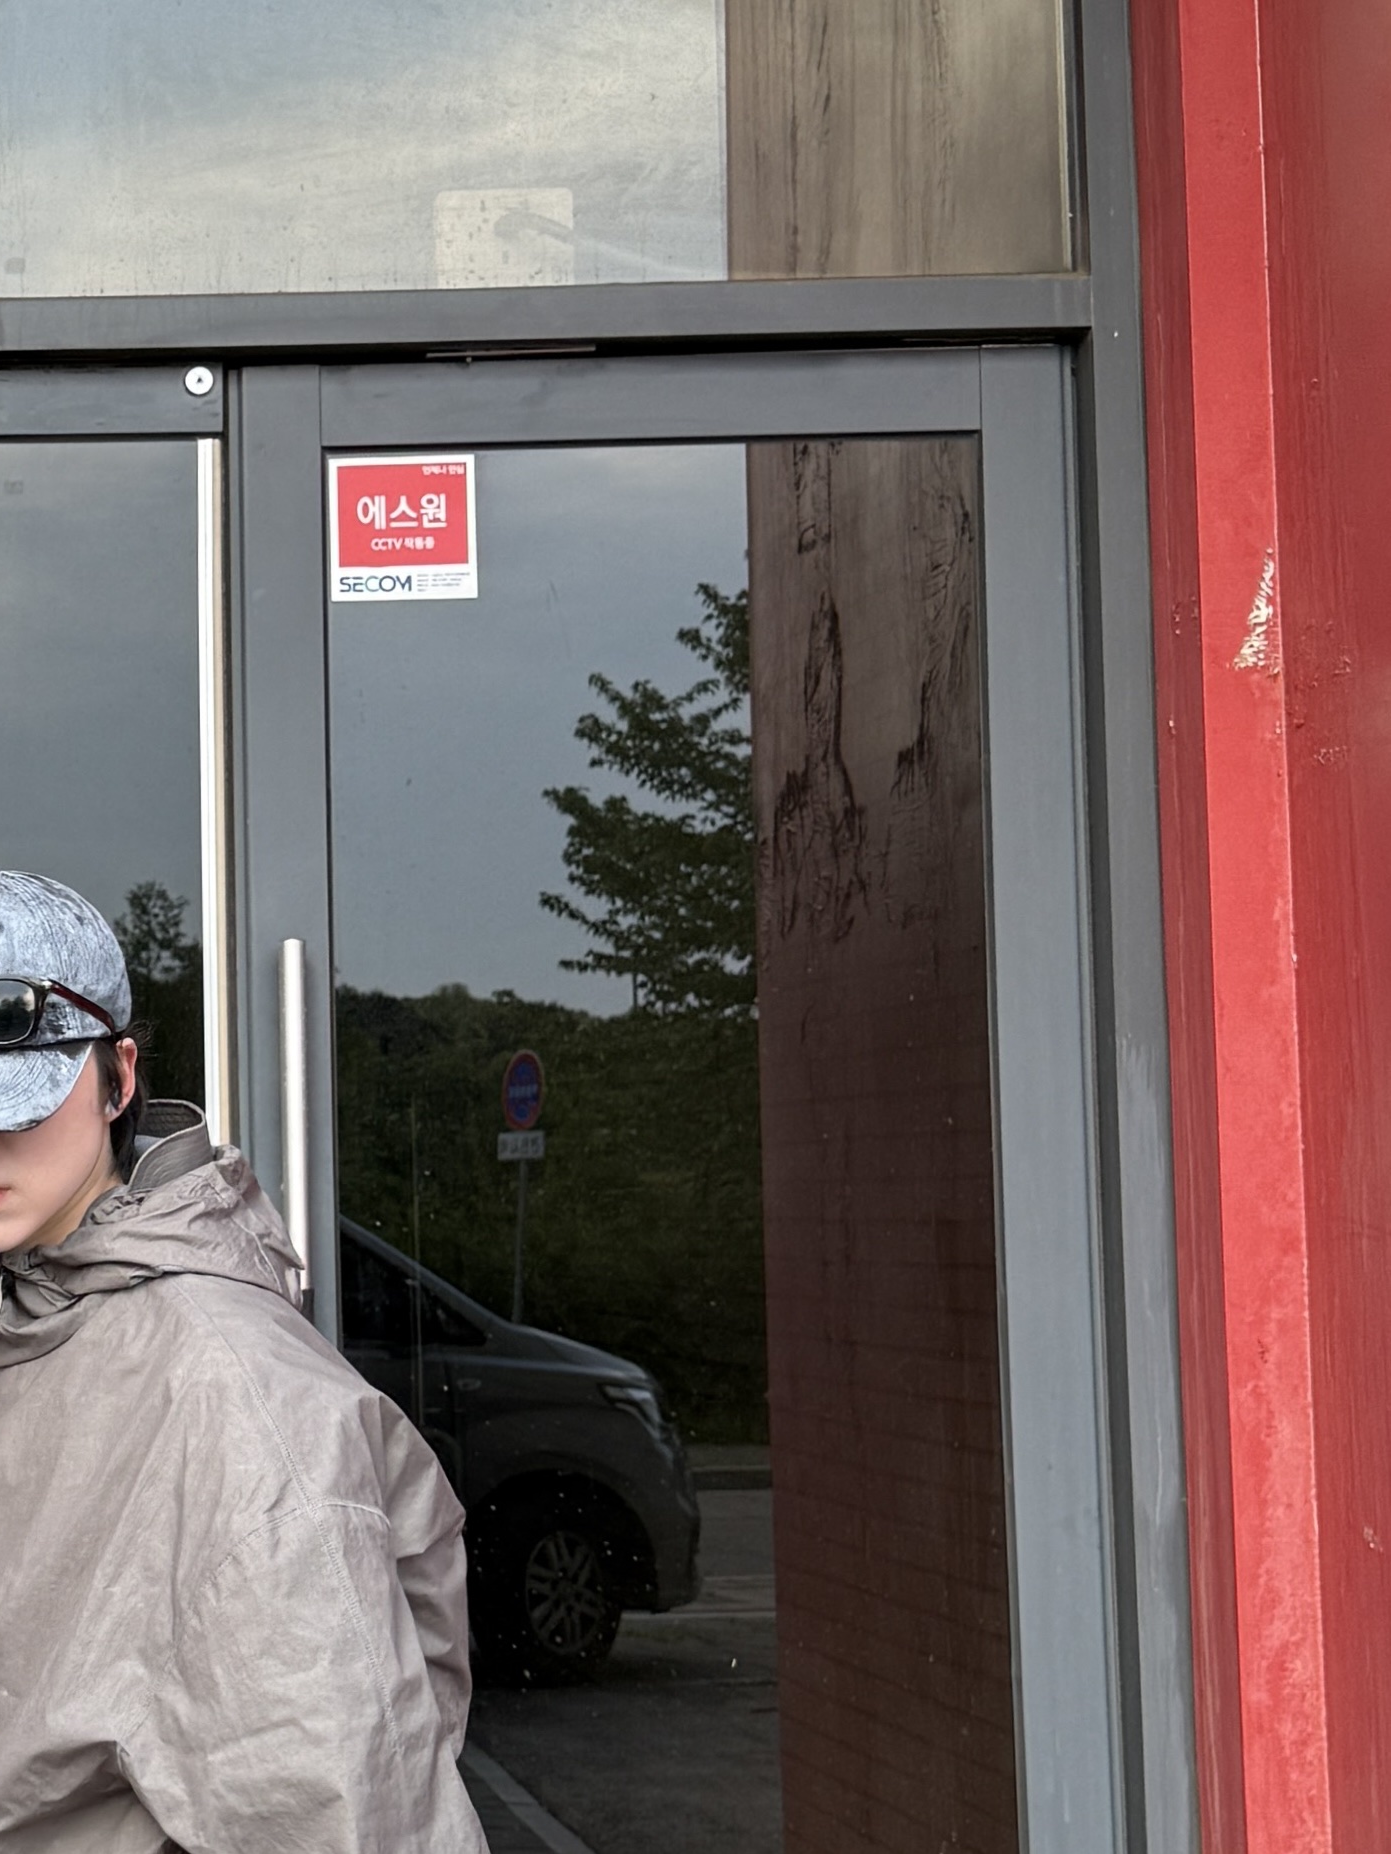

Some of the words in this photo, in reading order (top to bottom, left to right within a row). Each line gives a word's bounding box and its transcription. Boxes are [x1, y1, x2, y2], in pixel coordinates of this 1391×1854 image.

[356, 493, 447, 530] 에스원
[370, 537, 403, 551] CCTV
[339, 575, 412, 592] SECOM
